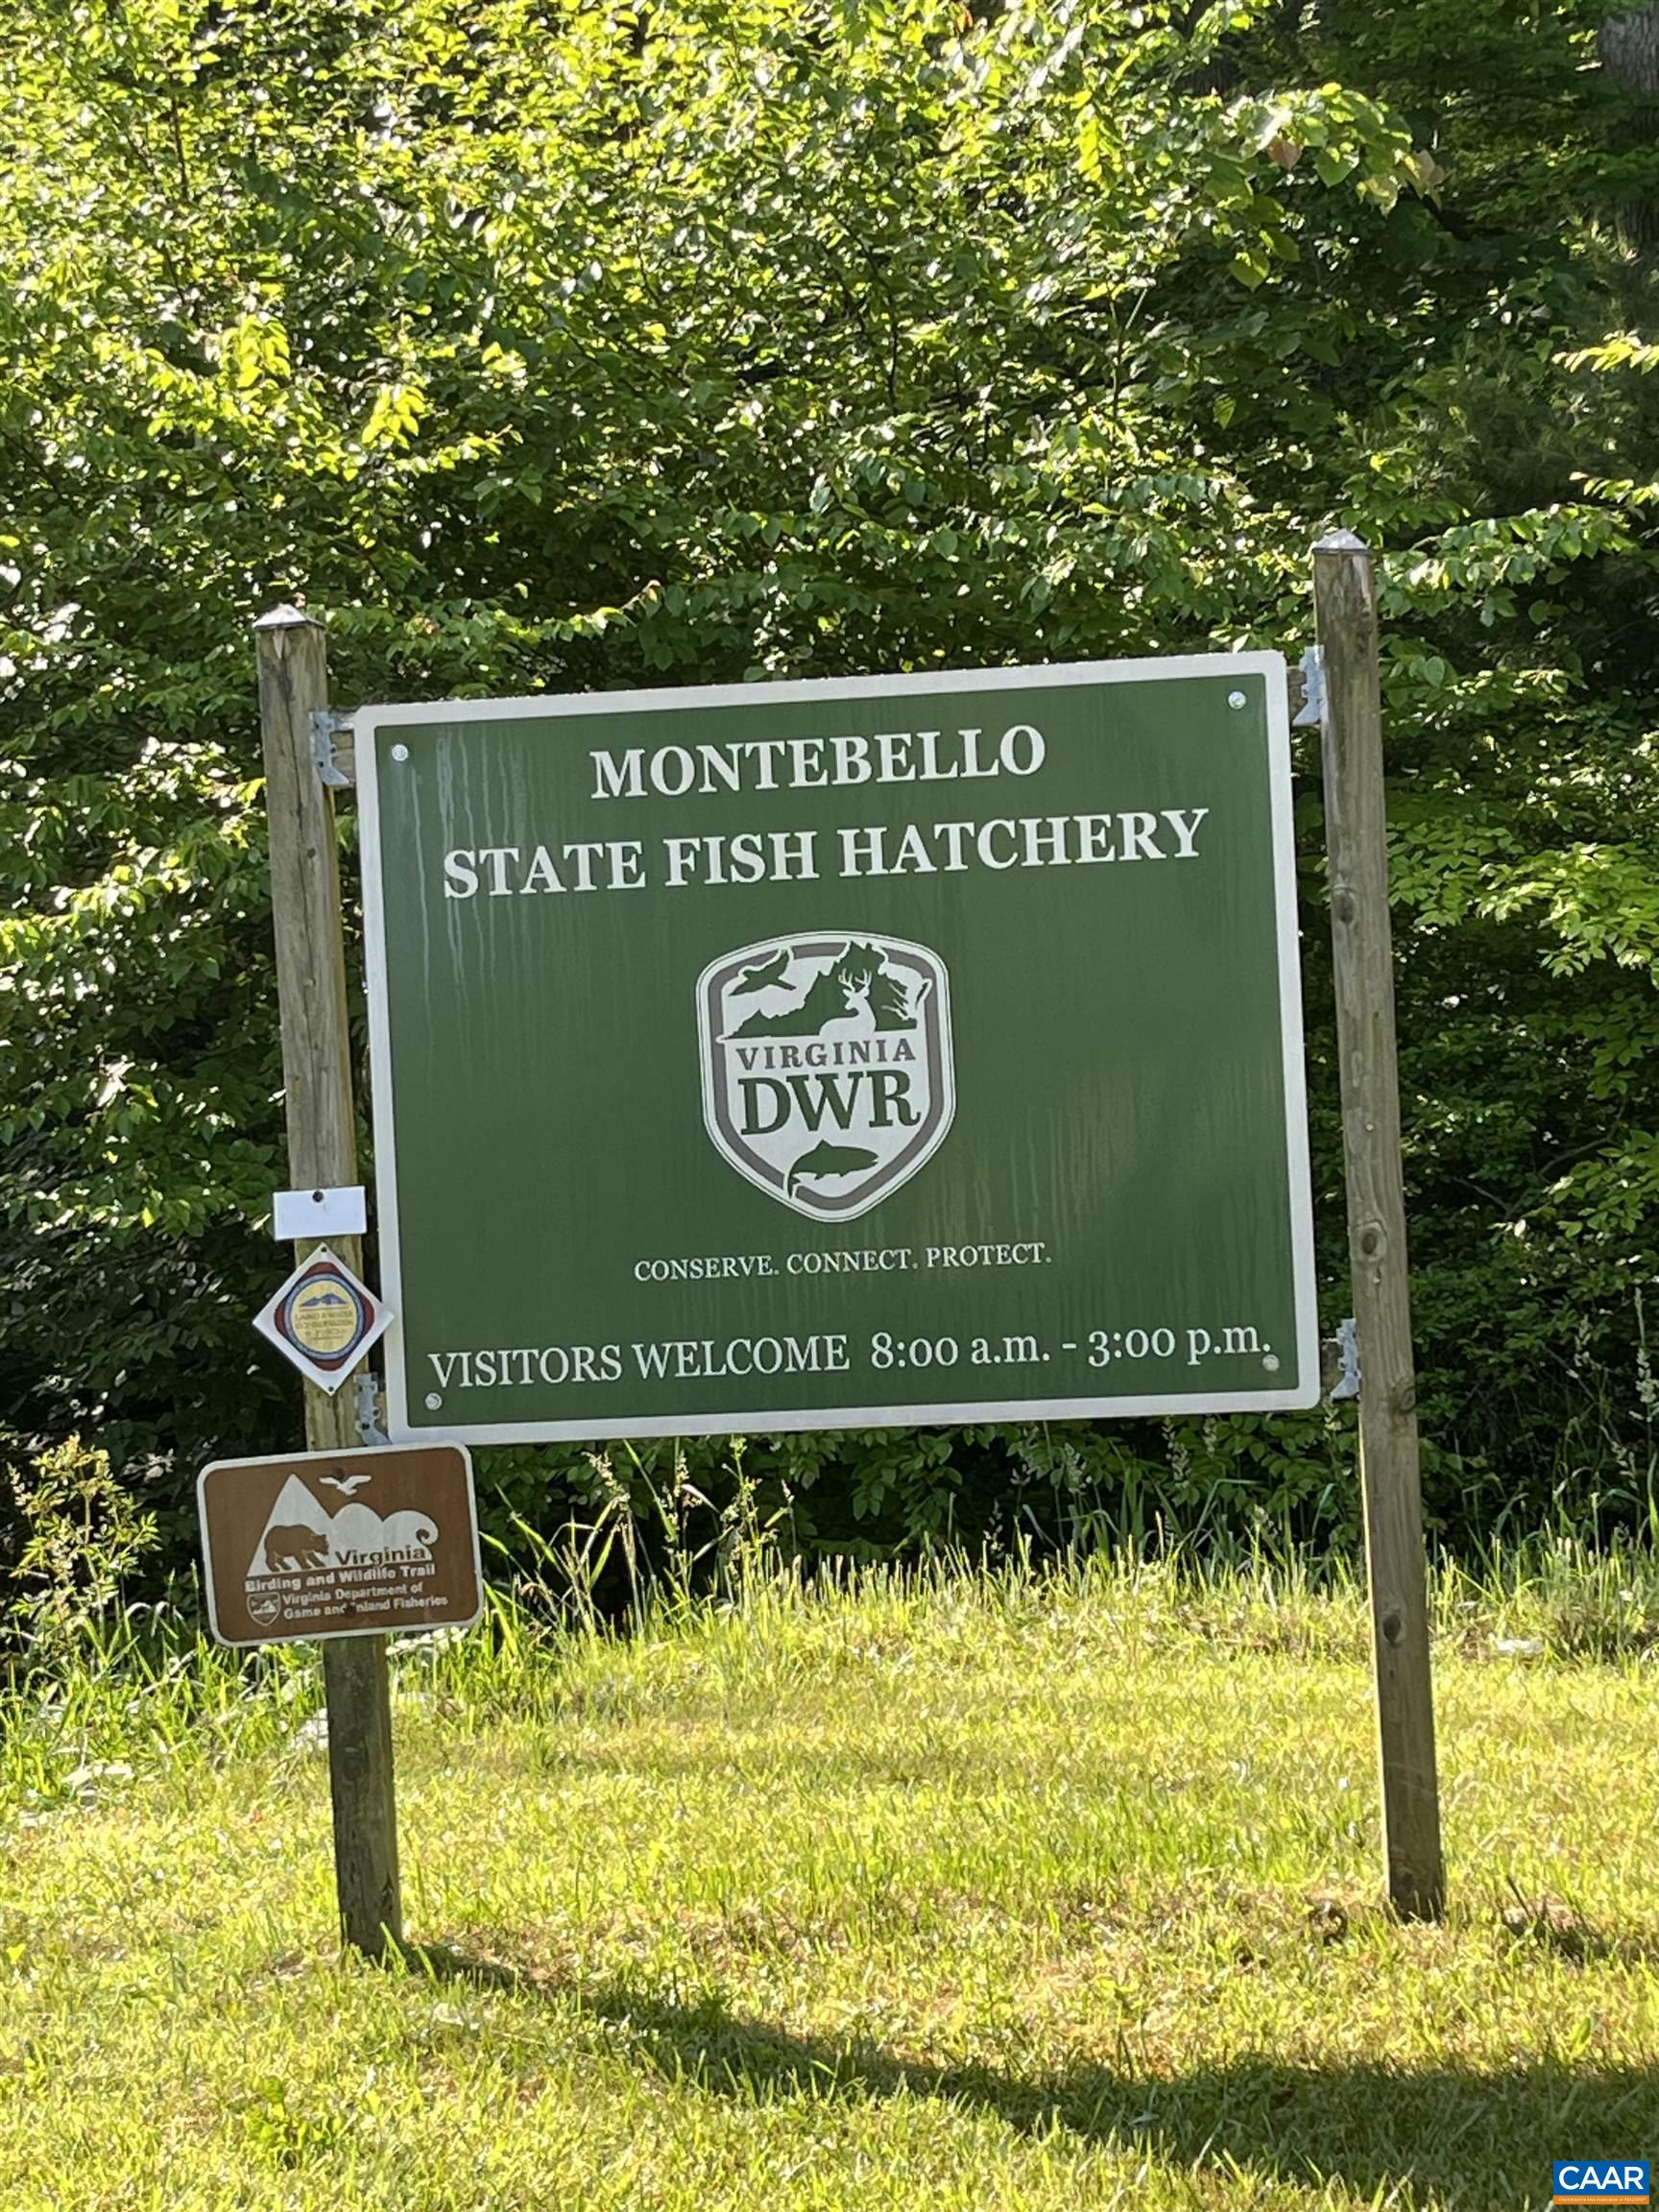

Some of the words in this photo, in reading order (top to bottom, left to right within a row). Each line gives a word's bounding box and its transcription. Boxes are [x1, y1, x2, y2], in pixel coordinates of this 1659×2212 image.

[590, 725, 1046, 799] MONTEBELLO
[444, 841, 646, 899] STATE
[662, 827, 820, 887] FISH
[837, 807, 1210, 878] HATCHERY
[734, 1038, 917, 1071] VIRGINIA
[736, 1069, 922, 1136] DWR
[634, 1254, 780, 1282] CONSERVE.
[786, 1248, 918, 1275] CONNECT.
[926, 1242, 1051, 1268] PROTECT.
[427, 1344, 622, 1388] VISITORS
[631, 1334, 850, 1379] WELCOME
[871, 1332, 958, 1369] 8:00
[971, 1334, 1050, 1364] a.m.
[1088, 1329, 1175, 1367] 3:00
[1187, 1326, 1270, 1365] p.m.
[335, 1545, 425, 1567] Virginia
[245, 1576, 301, 1593] Birding
[305, 1572, 335, 1587] and
[340, 1565, 397, 1583] Wildlife
[400, 1563, 436, 1577] Trail
[282, 1590, 331, 1605] Virginia
[335, 1584, 407, 1600] Department
[410, 1581, 423, 1593] of
[283, 1607, 321, 1620] Game
[351, 1599, 392, 1614] nland
[394, 1595, 448, 1610] Fisheries
